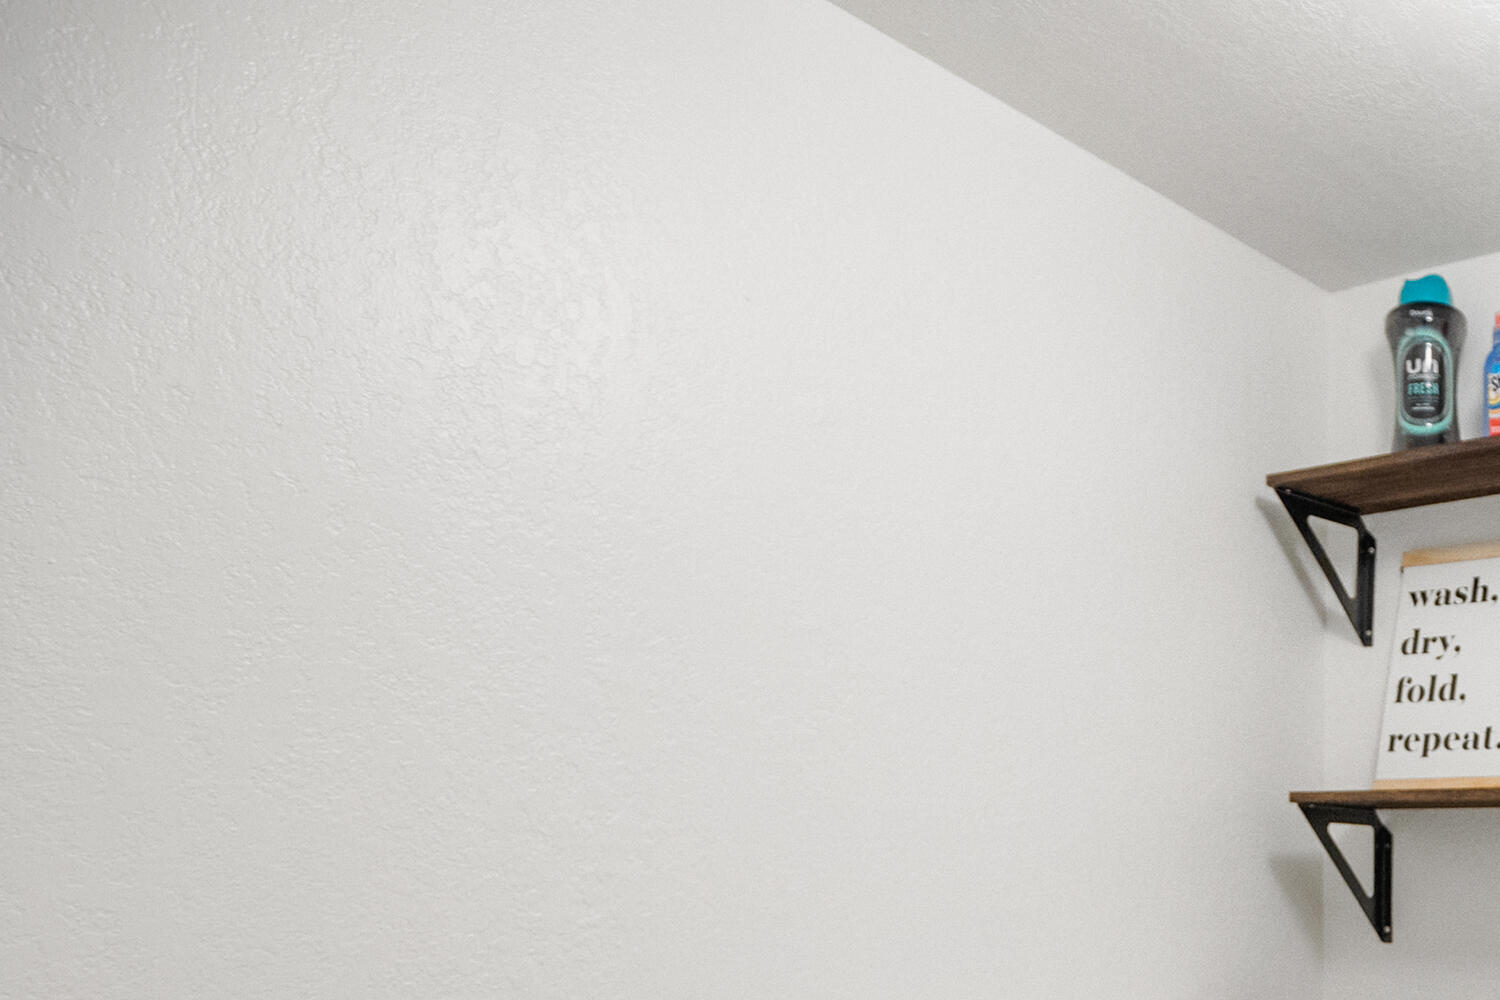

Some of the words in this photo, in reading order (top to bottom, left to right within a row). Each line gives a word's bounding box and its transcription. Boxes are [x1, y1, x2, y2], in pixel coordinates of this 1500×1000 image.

[1409, 576, 1499, 607] wash.
[1401, 628, 1461, 660] dry.
[1395, 673, 1466, 704] fold.
